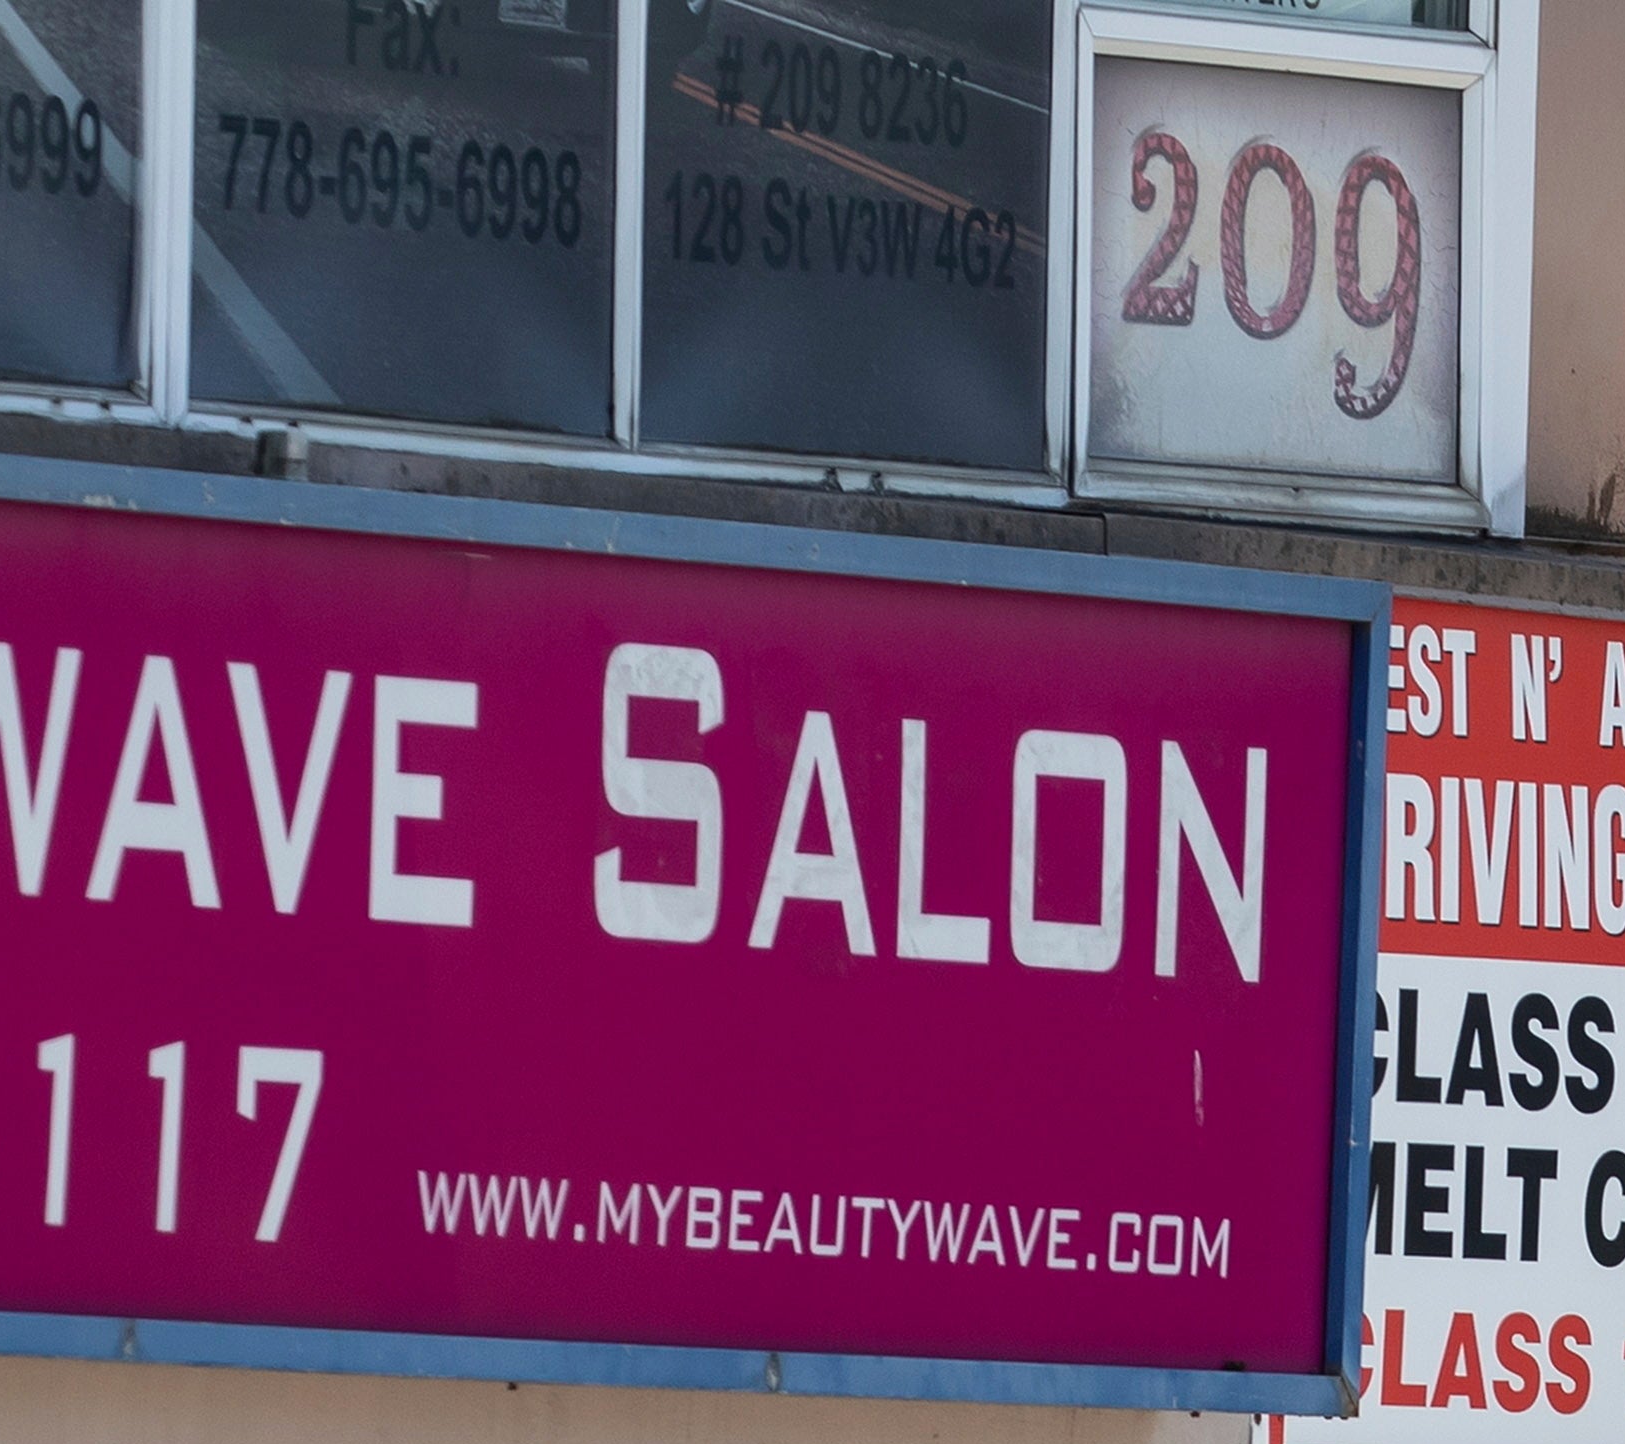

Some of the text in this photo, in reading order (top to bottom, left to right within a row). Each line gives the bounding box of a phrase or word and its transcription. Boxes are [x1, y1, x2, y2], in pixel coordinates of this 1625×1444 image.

[760, 39, 842, 136] 209
[858, 50, 969, 147] 8236
[218, 112, 582, 249] 778-695-6998
[667, 170, 1017, 290] 128 St V3W 4G2
[1120, 131, 1422, 420] 209
[594, 642, 1269, 985] SALON
[417, 1169, 1232, 1279] WWW.MYBEAUTYWAVE.COM
